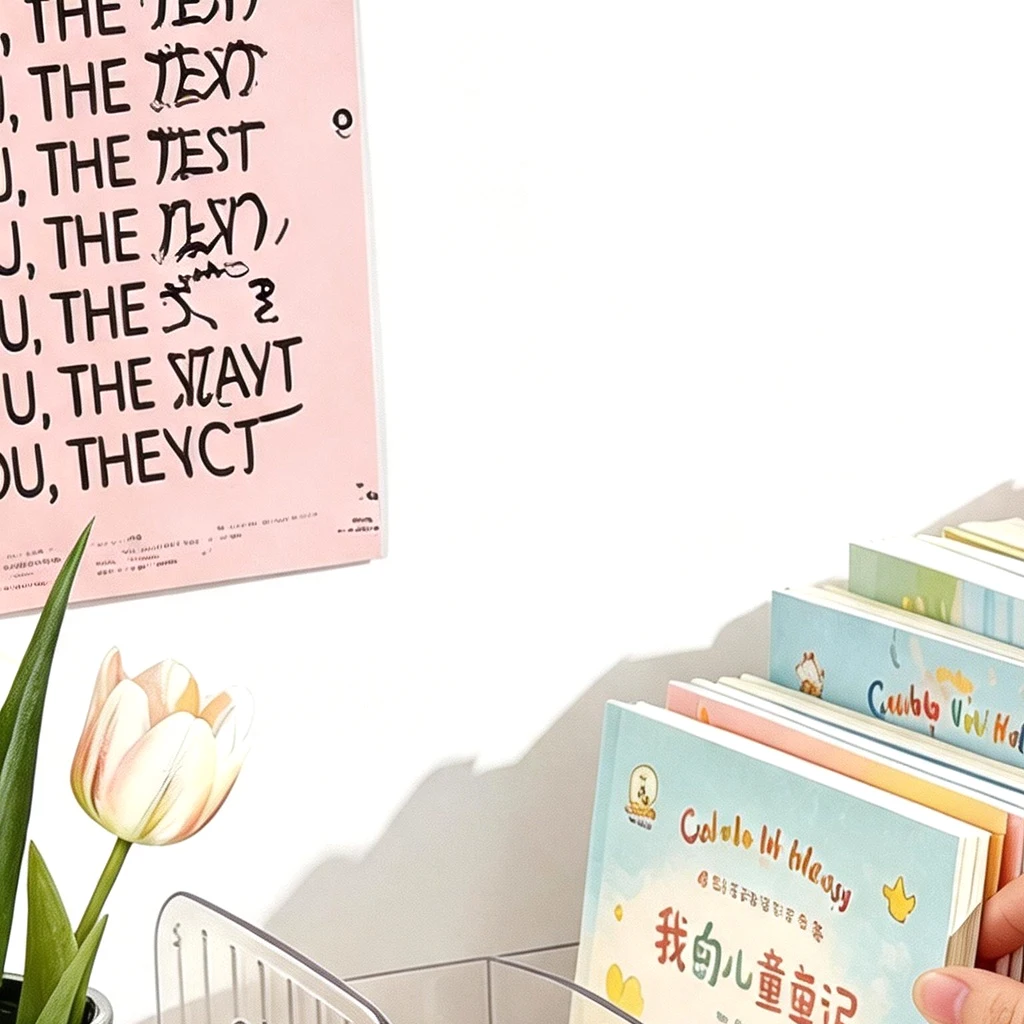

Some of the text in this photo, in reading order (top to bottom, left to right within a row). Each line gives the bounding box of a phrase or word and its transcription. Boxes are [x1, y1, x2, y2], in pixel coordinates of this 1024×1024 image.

[24, 0, 126, 43] THE
[28, 58, 130, 121] THE
[36, 135, 136, 196] THE
[147, 121, 265, 184] TEST
[44, 209, 140, 269] THE
[50, 282, 148, 343] THE
[57, 357, 155, 417] THE
